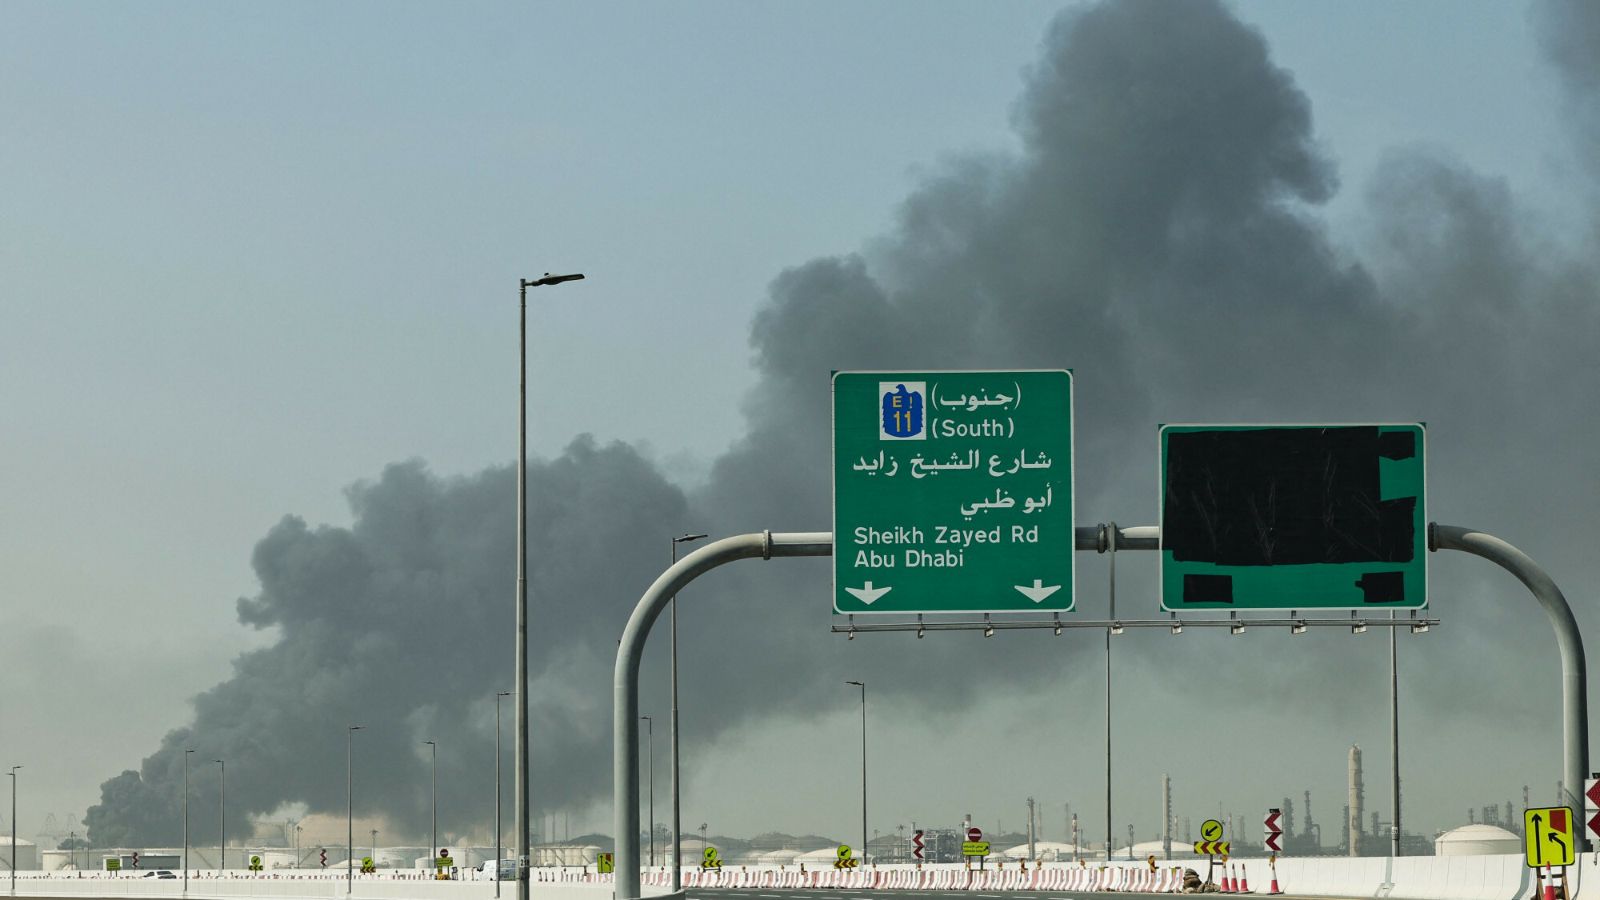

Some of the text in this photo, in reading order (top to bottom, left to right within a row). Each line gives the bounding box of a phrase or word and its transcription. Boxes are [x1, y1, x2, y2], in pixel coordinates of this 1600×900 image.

[892, 395, 902, 408] E
[931, 381, 1021, 412] (جنوب)
[894, 410, 911, 432] 11
[932, 417, 1014, 439] (South)
[853, 449, 1052, 479] شارع الشيخ زايد
[960, 482, 1052, 521] أبو ظبي
[854, 525, 1038, 547] Sheikh Zayed Rd
[854, 548, 964, 568] Abu Dhabi
